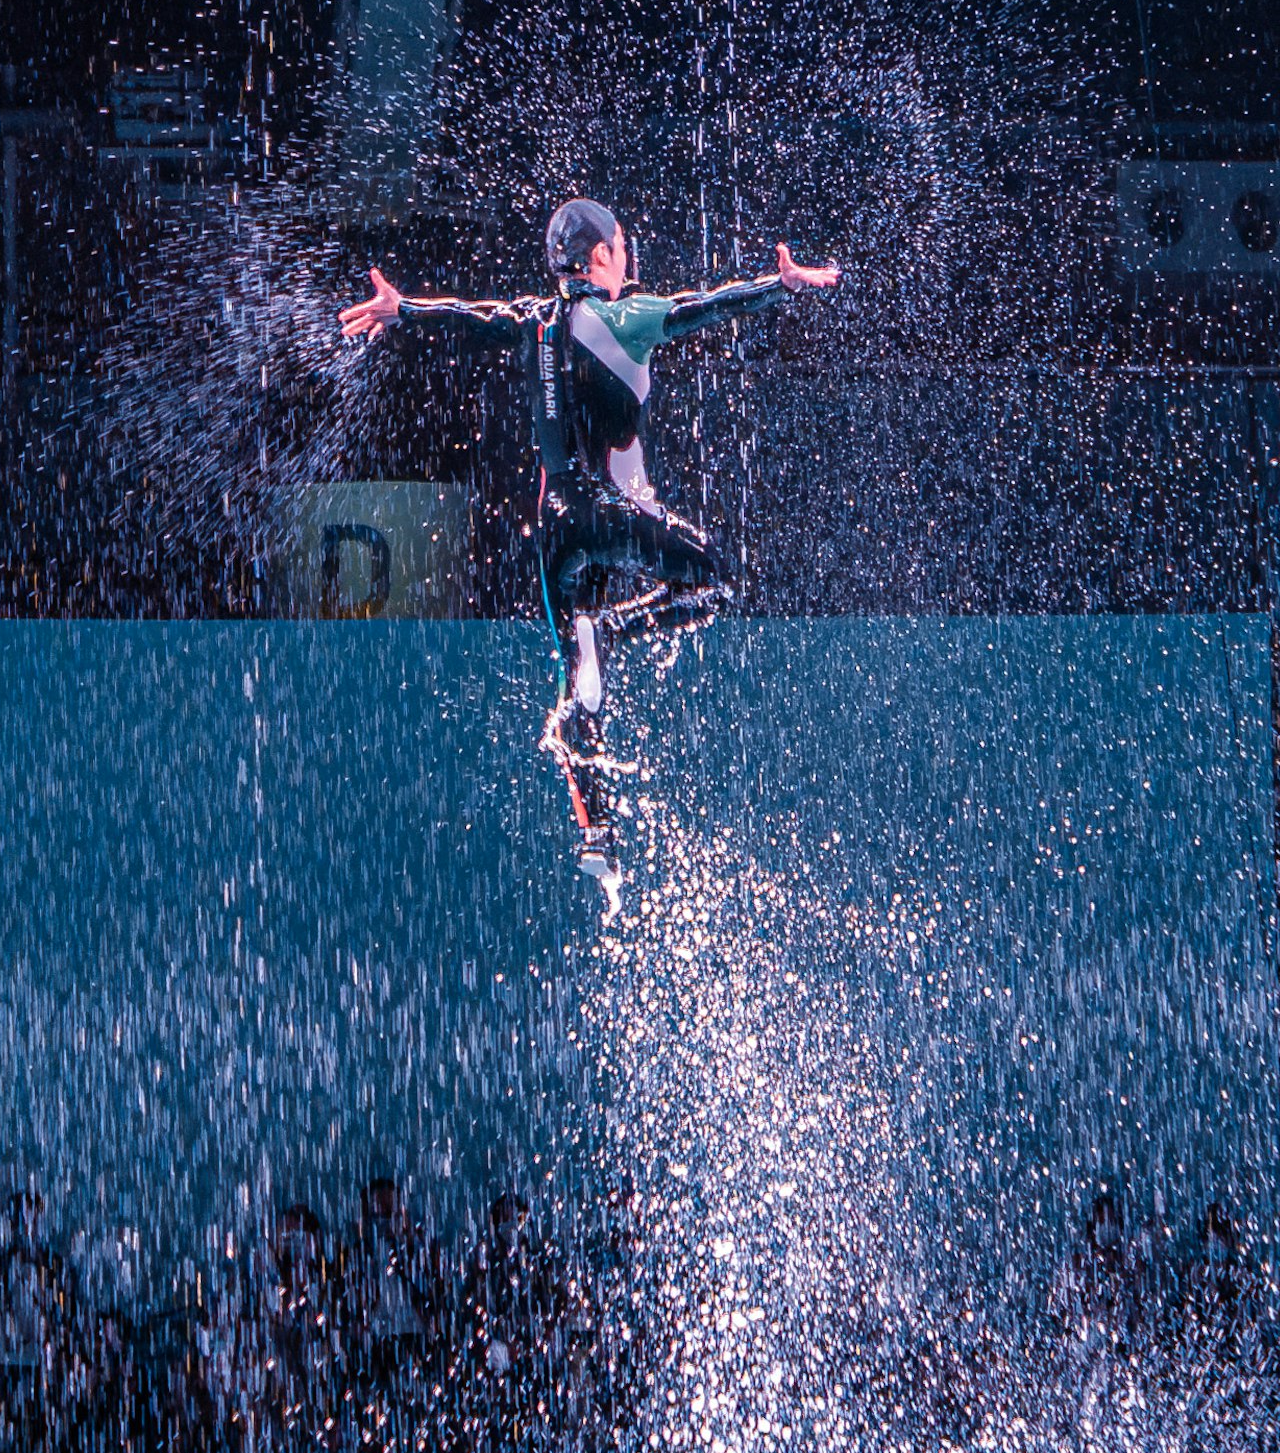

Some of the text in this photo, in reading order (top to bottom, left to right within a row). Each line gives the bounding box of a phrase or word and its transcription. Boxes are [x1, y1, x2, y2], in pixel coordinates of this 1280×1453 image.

[542, 343, 559, 420] AQUA PARK
[321, 523, 391, 620] D
